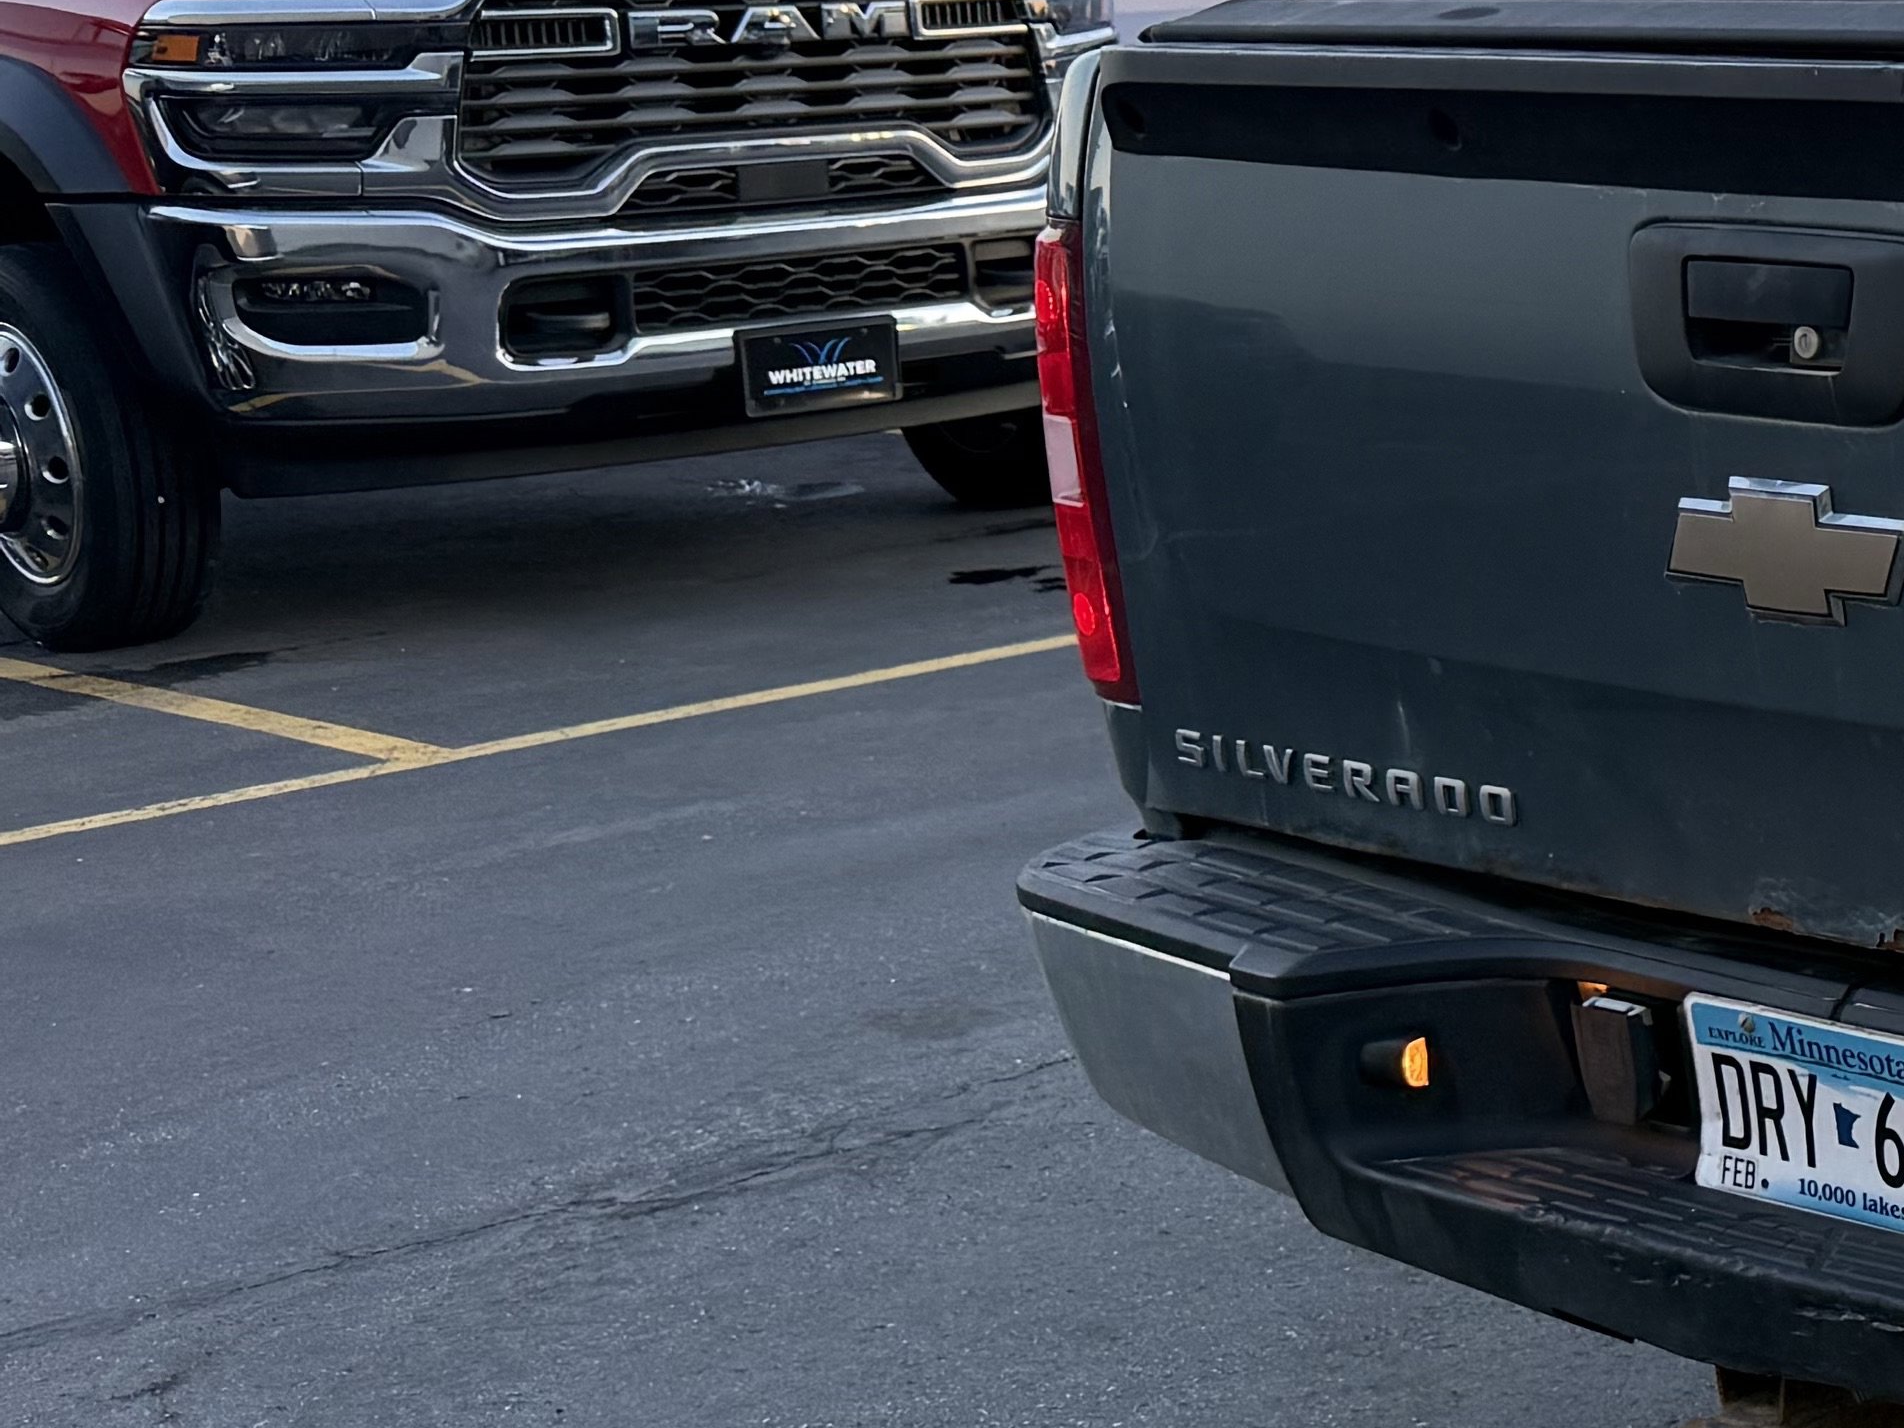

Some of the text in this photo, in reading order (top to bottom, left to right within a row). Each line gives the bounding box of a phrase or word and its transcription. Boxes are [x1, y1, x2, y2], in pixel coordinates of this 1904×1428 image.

[628, 0, 907, 49] RAM
[768, 359, 877, 385] WHITEWATER
[1174, 728, 1518, 827] SILVERADO
[1707, 1025, 1767, 1049] EXPLORE
[1711, 1052, 1818, 1169] DRY
[1720, 1154, 1757, 1190] FEB
[1797, 1177, 1857, 1209] 10,000
